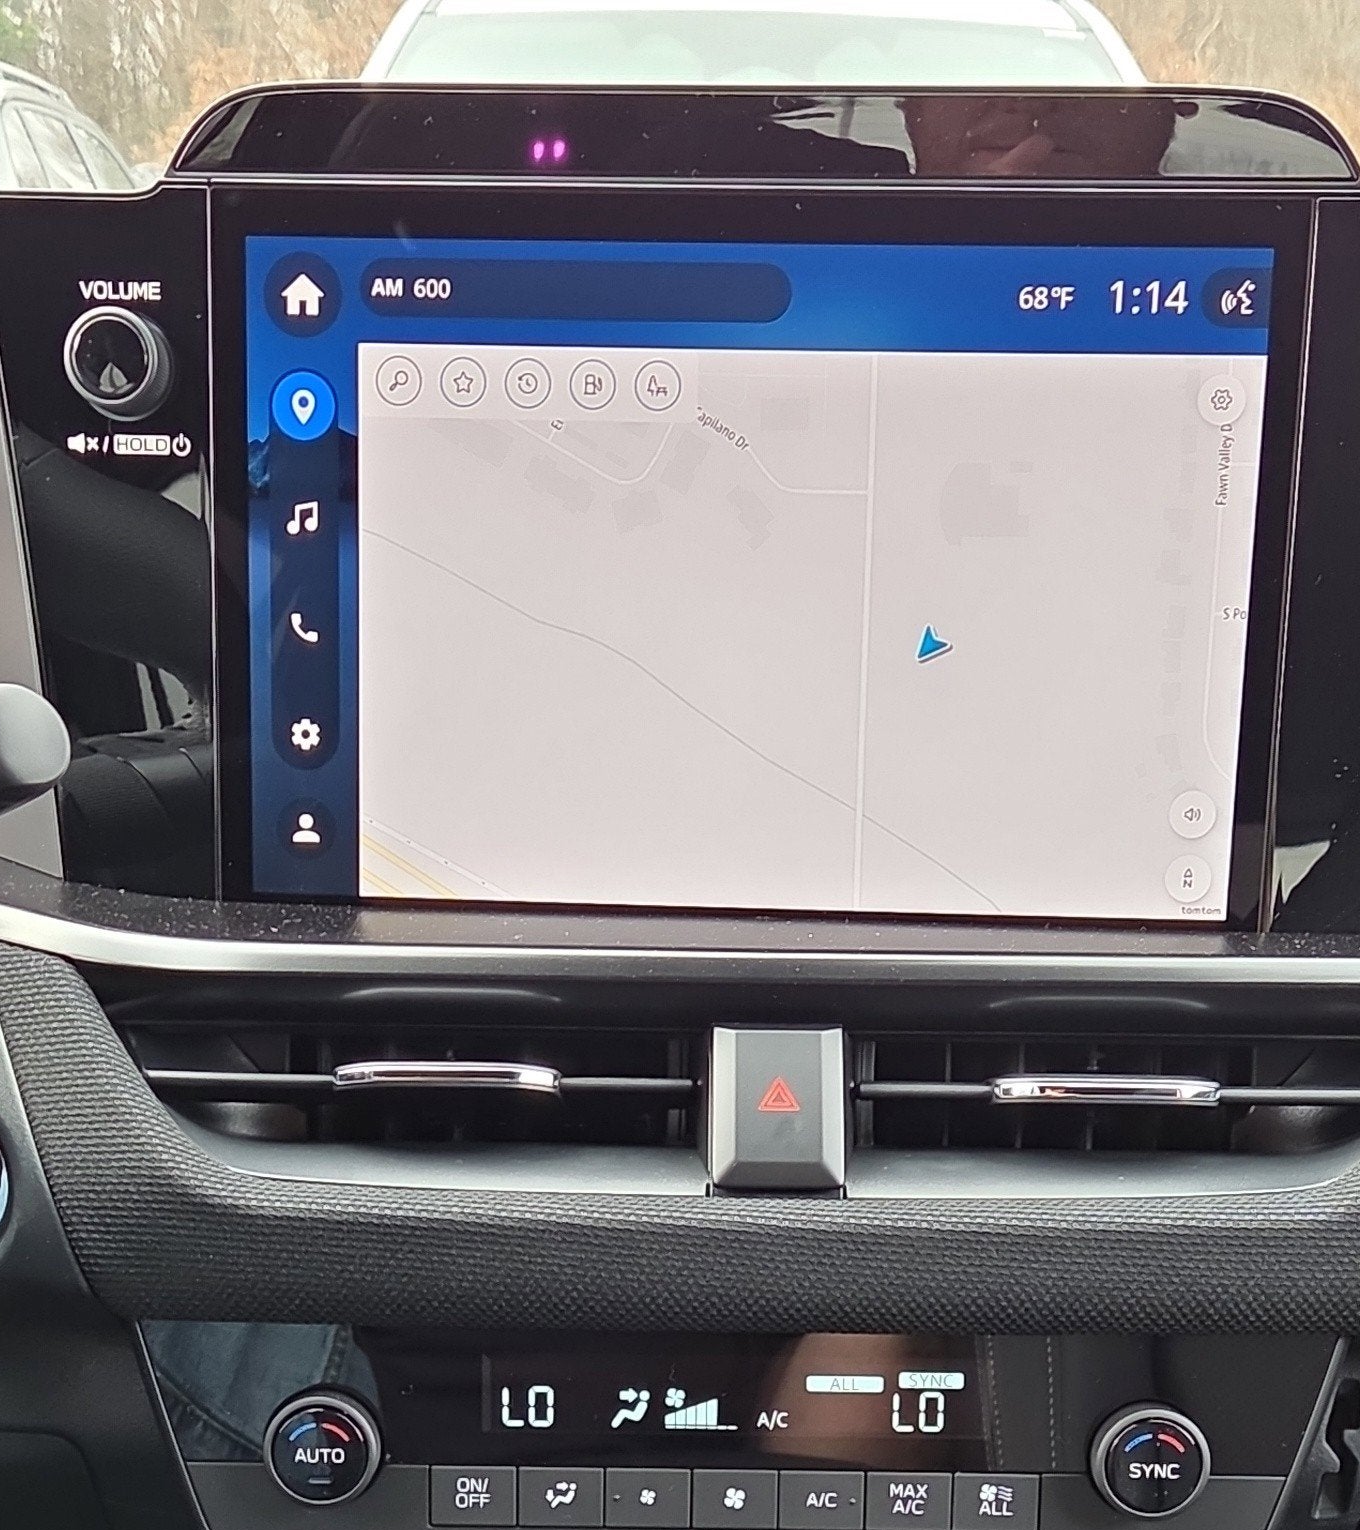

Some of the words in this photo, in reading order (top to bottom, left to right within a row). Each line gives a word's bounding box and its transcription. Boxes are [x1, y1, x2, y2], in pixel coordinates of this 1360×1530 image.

[78, 280, 162, 301] VOLUME
[370, 277, 404, 298] AM
[413, 277, 452, 300] 600
[1018, 285, 1076, 310] 68°F
[1109, 280, 1189, 315] 1:14
[697, 406, 736, 441] apilano
[734, 435, 750, 451] Dr
[116, 438, 168, 451] HOLD
[1218, 435, 1235, 471] Valley
[1215, 474, 1229, 505] Fawn
[1182, 879, 1192, 888] N
[1181, 906, 1222, 915] tomtom
[830, 1377, 860, 1392] ALL
[908, 1373, 955, 1389] SYNC
[501, 1385, 555, 1428] LO
[892, 1391, 945, 1433] LO
[756, 1409, 789, 1430] A/C
[294, 1447, 346, 1465] AUTO
[1128, 1462, 1181, 1480] SYNC
[456, 1477, 489, 1493] ON/
[889, 1483, 929, 1499] MAX
[454, 1493, 491, 1509] OFF
[806, 1492, 838, 1509] A/C
[892, 1499, 926, 1516] A/C
[978, 1501, 1014, 1517] ALL
